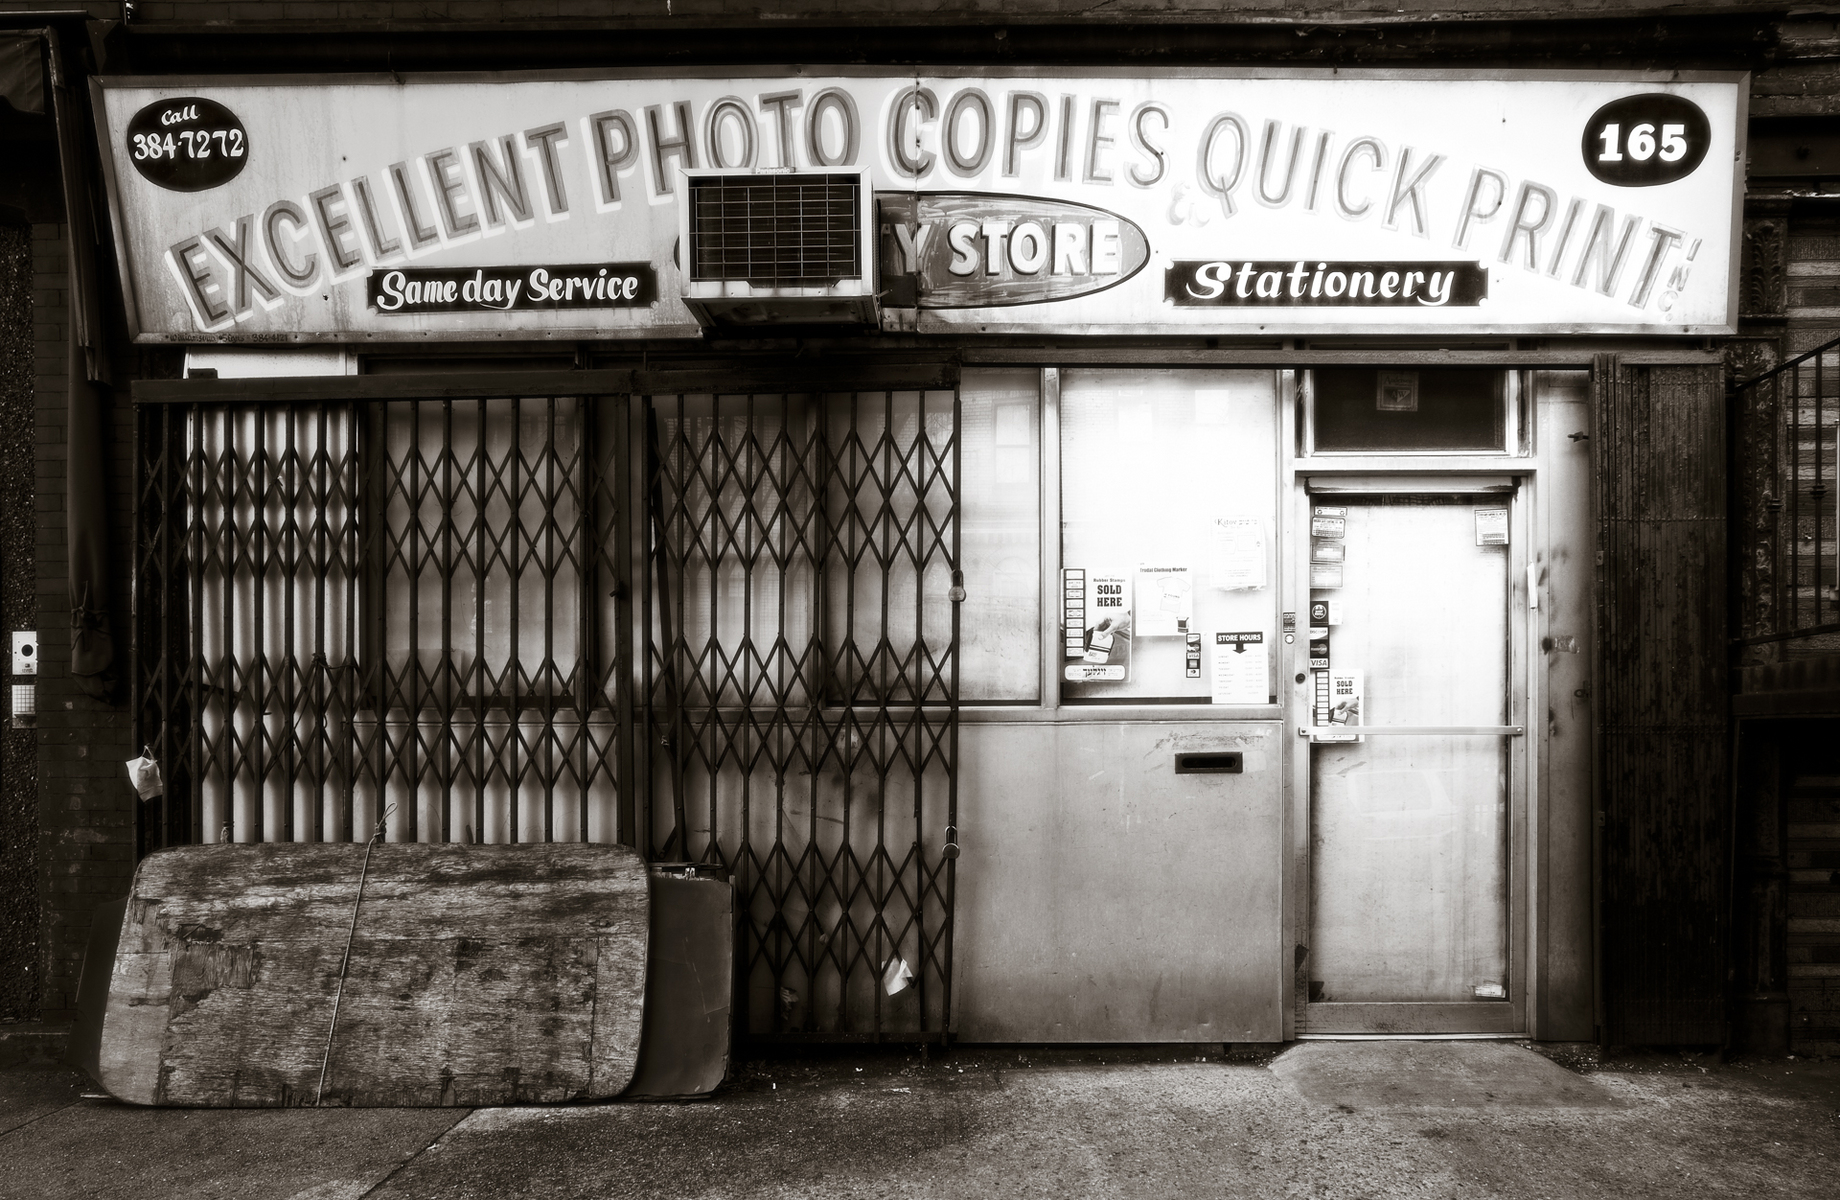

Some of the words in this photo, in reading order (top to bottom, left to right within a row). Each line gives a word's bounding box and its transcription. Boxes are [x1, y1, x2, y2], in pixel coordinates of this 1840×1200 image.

[161, 106, 199, 126] Call
[1598, 122, 1688, 162] 165
[755, 167, 791, 175] Panasonic
[167, 120, 569, 330] EXCELLENT
[584, 86, 861, 208] PHOTO
[884, 85, 1172, 190] COPIES
[1195, 111, 1447, 240] QUICK
[948, 219, 1122, 277] STORE
[376, 269, 456, 311] Same
[461, 268, 521, 310] day
[525, 268, 639, 302] Service
[1185, 261, 1456, 306] Stationery
[1097, 584, 1122, 595] SOLD
[1097, 597, 1122, 607] HERE
[1217, 634, 1239, 642] STORE
[1239, 633, 1262, 642] HOURS
